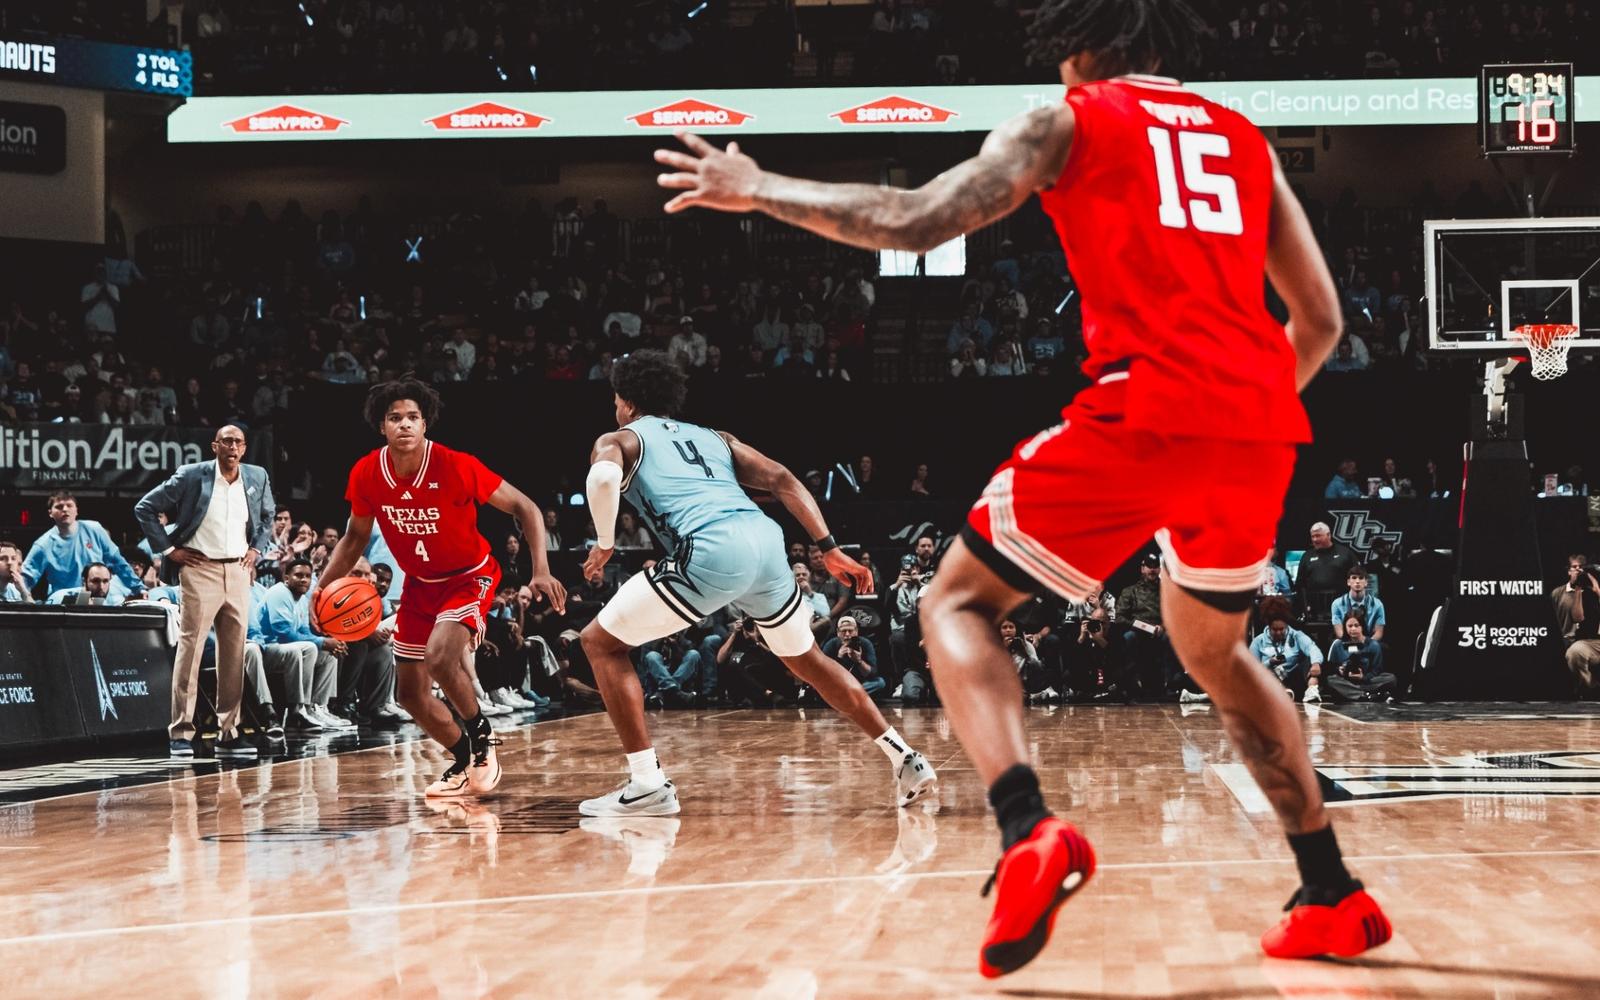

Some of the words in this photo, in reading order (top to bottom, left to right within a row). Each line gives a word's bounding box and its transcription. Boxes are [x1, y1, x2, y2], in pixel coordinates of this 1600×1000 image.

[136, 53, 147, 69] 3
[150, 54, 180, 72] TOL
[135, 71, 146, 86] 4
[1508, 72, 1563, 97] 9:34
[1221, 90, 1244, 112] in
[1250, 89, 1358, 117] Cleanup
[1368, 87, 1419, 111] and
[248, 115, 324, 131] SERVPRO
[449, 113, 526, 128] SERVPRO
[652, 110, 728, 125] SERVPRO
[856, 107, 934, 122] SERVPRO
[1517, 100, 1557, 143] 16
[0, 118, 38, 145] ion
[1147, 126, 1244, 236] 15
[94, 427, 202, 471] Arena
[671, 439, 715, 479] 4
[32, 470, 92, 481] FINANCIAL
[381, 505, 441, 522] TEXAS
[392, 519, 440, 535] TECH
[414, 539, 430, 562] 4
[1459, 580, 1497, 596] FIRST
[1499, 580, 1543, 596] WATCH
[1490, 627, 1548, 638] ROOFING
[8, 685, 36, 704] FORCE
[109, 681, 129, 698] SPACE
[128, 680, 150, 696] FORCE
